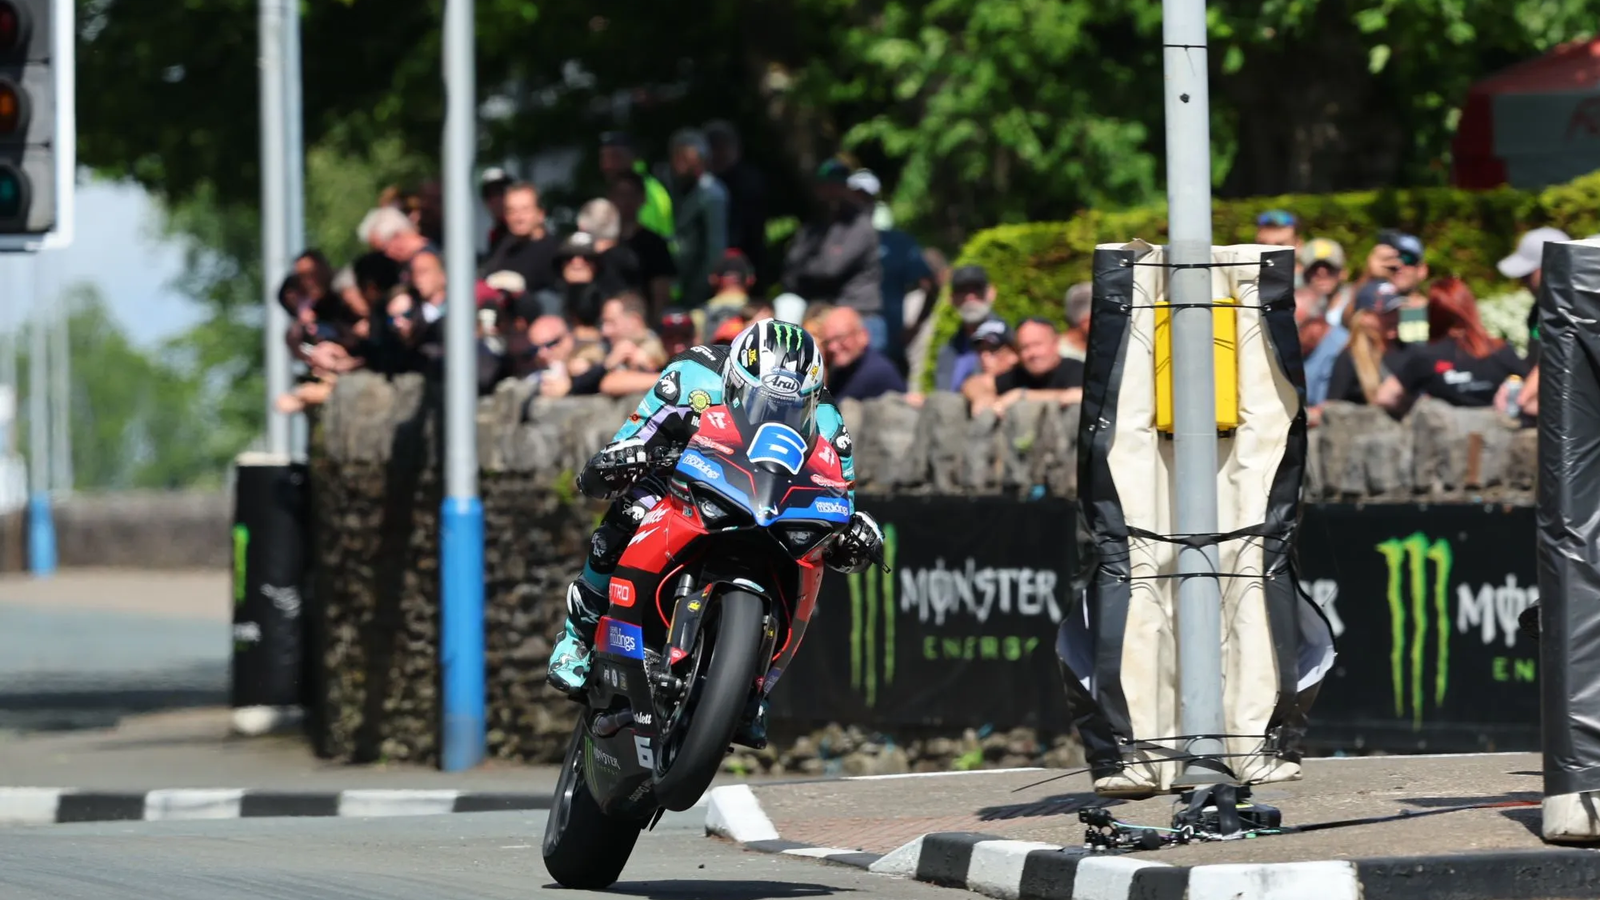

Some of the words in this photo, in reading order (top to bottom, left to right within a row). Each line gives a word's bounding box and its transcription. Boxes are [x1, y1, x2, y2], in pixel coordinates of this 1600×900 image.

[764, 375, 796, 390] Arai
[900, 556, 1063, 626] MONSTER
[633, 734, 655, 770] 6
